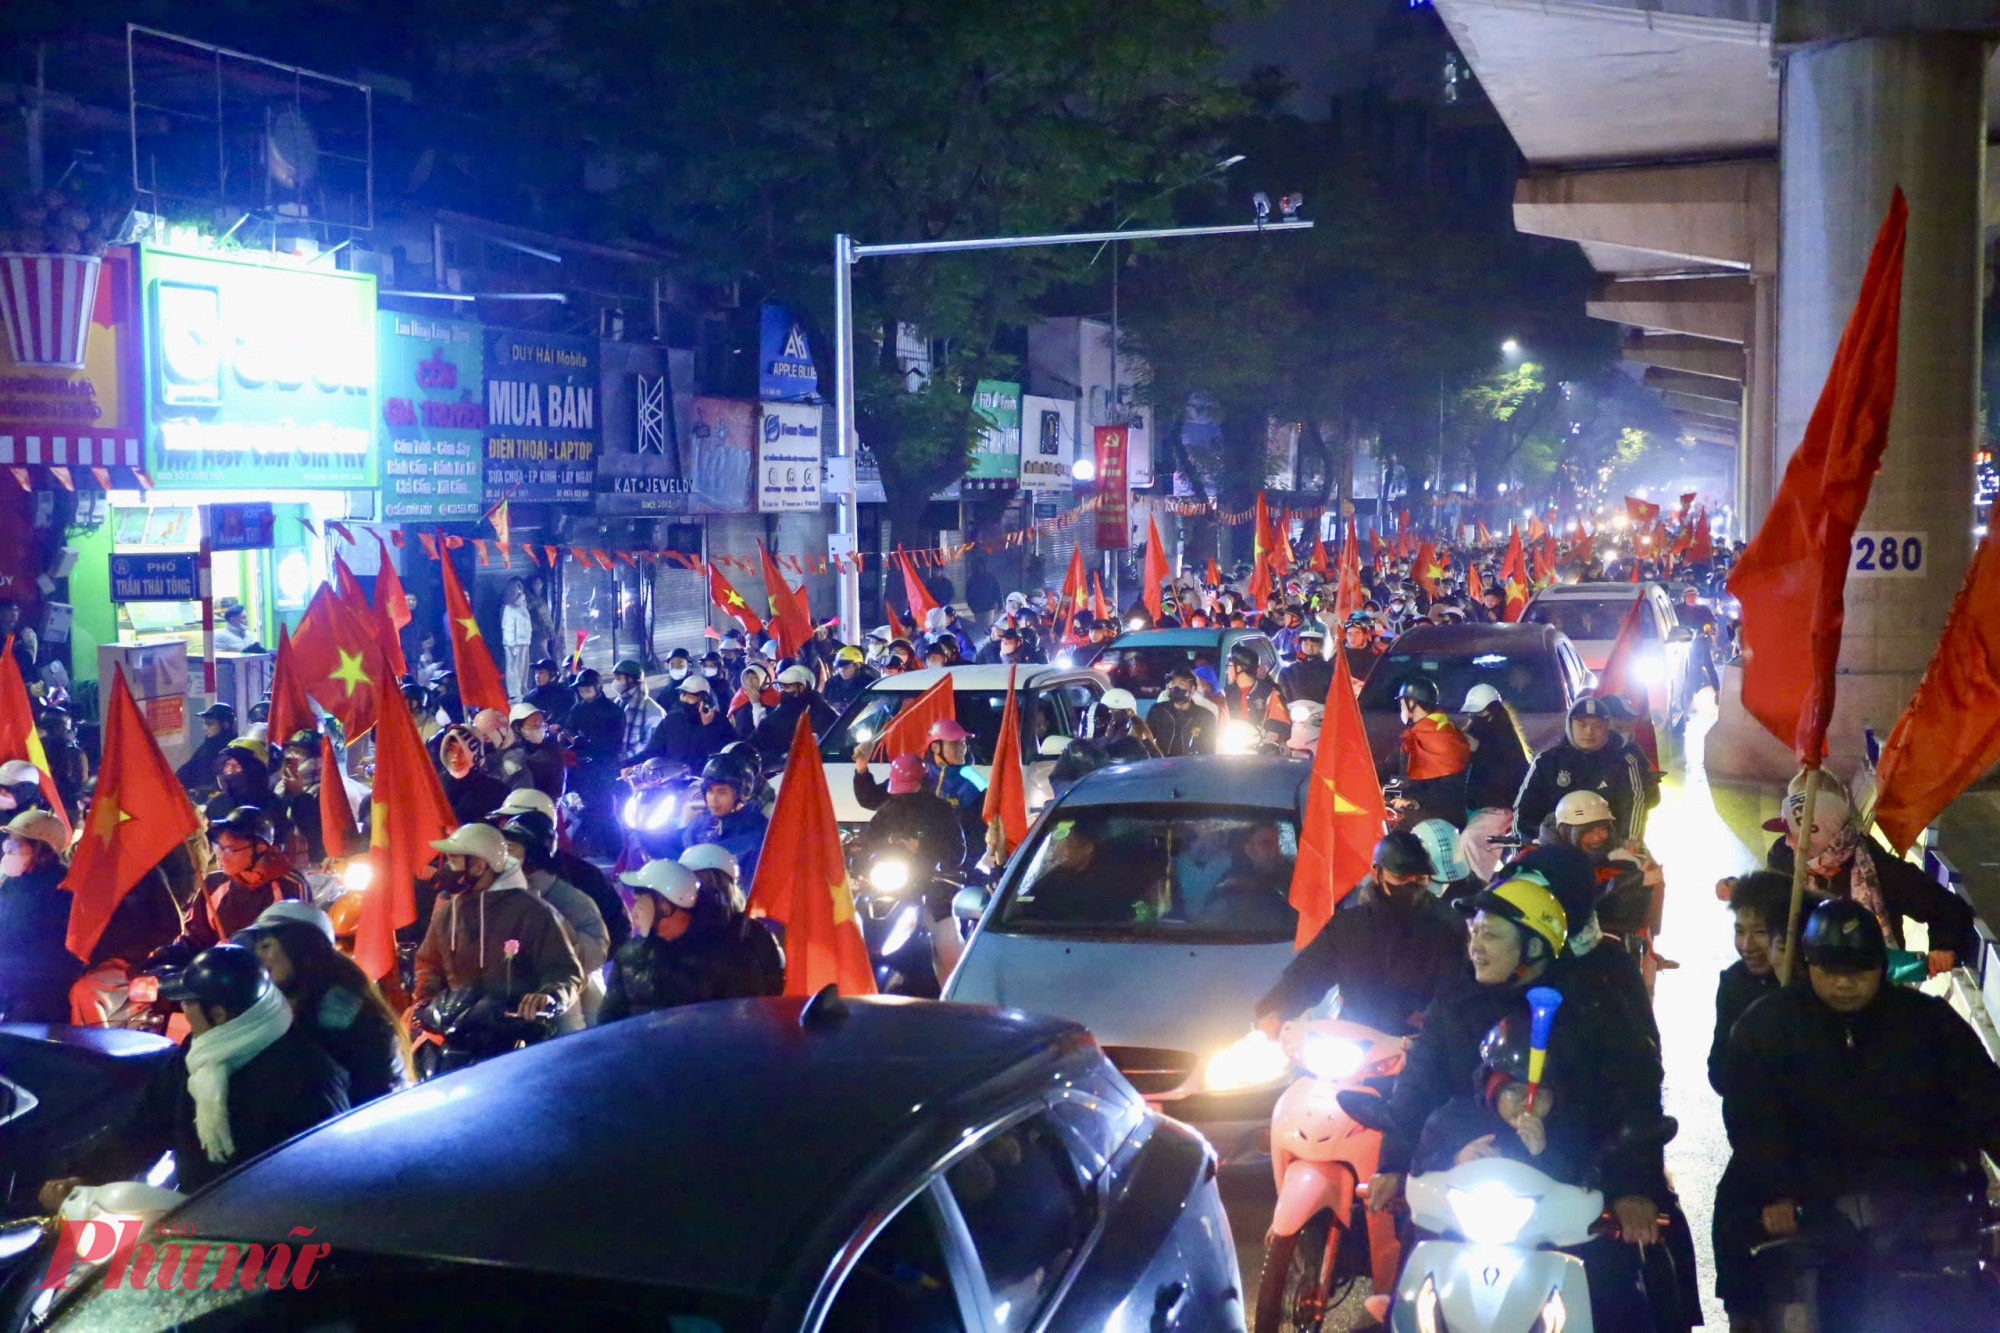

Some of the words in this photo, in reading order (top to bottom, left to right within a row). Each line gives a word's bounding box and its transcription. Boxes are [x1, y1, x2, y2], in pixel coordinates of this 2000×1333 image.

[512, 344, 535, 361] DUY
[556, 350, 588, 368] Mobile
[773, 362, 797, 378] APPLE
[489, 380, 542, 427] MUA
[548, 375, 593, 430] BÁN
[488, 433, 515, 464] ĐIỆN
[516, 438, 548, 464] THOẠI
[554, 441, 593, 461] LAPTOP
[614, 477, 638, 493] KAT
[1856, 536, 1922, 571] 280
[146, 559, 177, 573] PHỐ
[142, 575, 164, 595] THÁI
[166, 575, 191, 595] TÔNG
